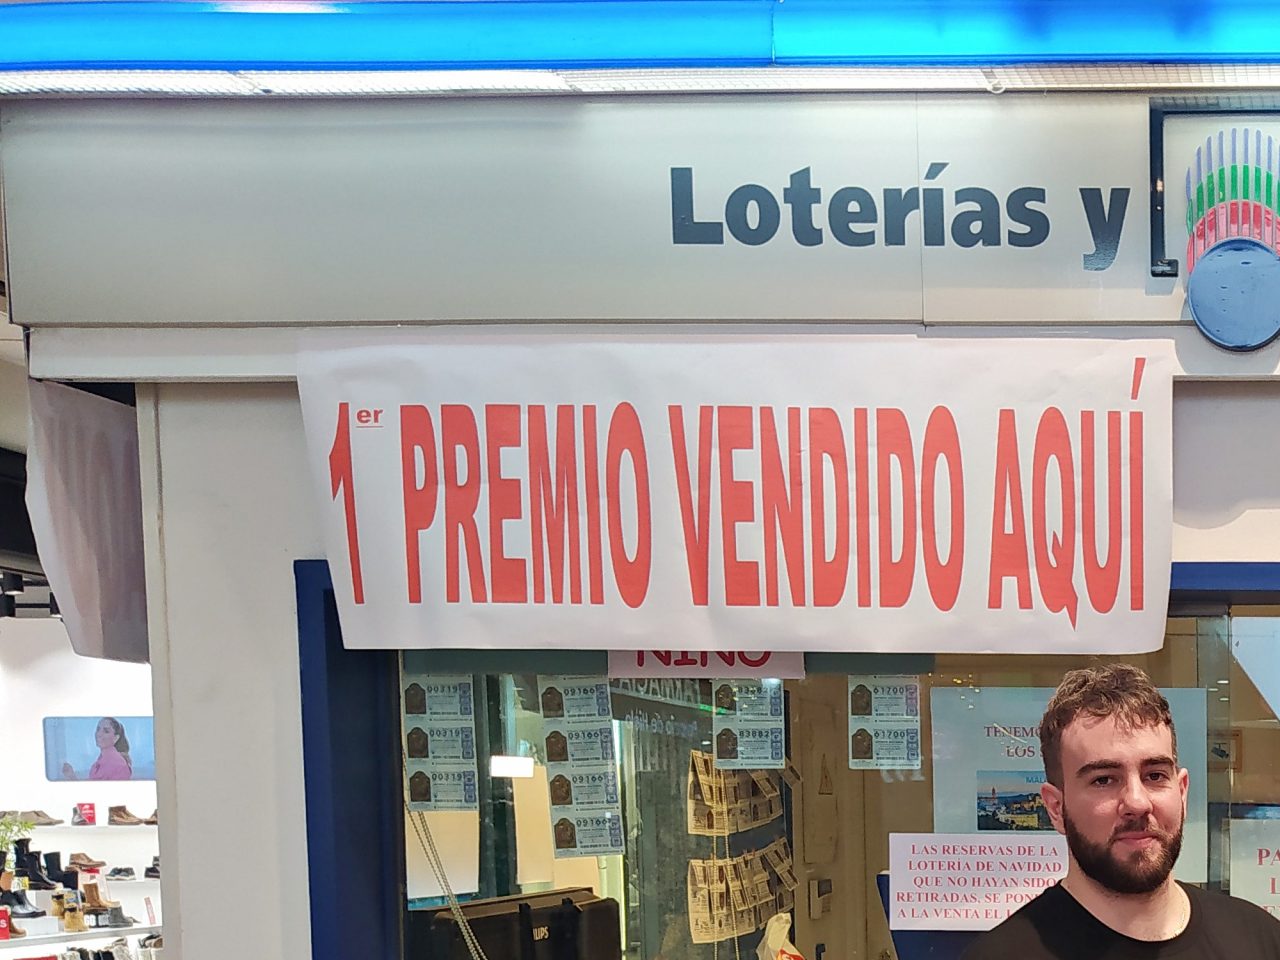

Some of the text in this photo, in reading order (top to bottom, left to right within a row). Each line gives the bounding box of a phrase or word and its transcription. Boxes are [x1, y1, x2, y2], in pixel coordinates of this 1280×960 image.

[670, 162, 1051, 247] Loterías
[1080, 187, 1130, 271] y
[403, 401, 654, 610] PREMIO
[670, 404, 964, 612] VENDIDO
[988, 357, 1146, 632] AQUÍ
[427, 685, 458, 693] 00319
[873, 685, 905, 695] 61700
[429, 729, 460, 738] 00319
[873, 729, 905, 738] 61700
[1006, 746, 1035, 757] LOS
[432, 773, 462, 781] 00319
[911, 844, 1058, 857] LAS RESERVAS DE LA
[908, 859, 1062, 873] LOTERÍA DE NAVIDAD
[913, 876, 943, 888] QUE
[947, 877, 967, 887] NO
[971, 877, 1019, 888] HAYAN
[984, 892, 1001, 903] SE
[897, 908, 1002, 919] A LA VENTA EL
